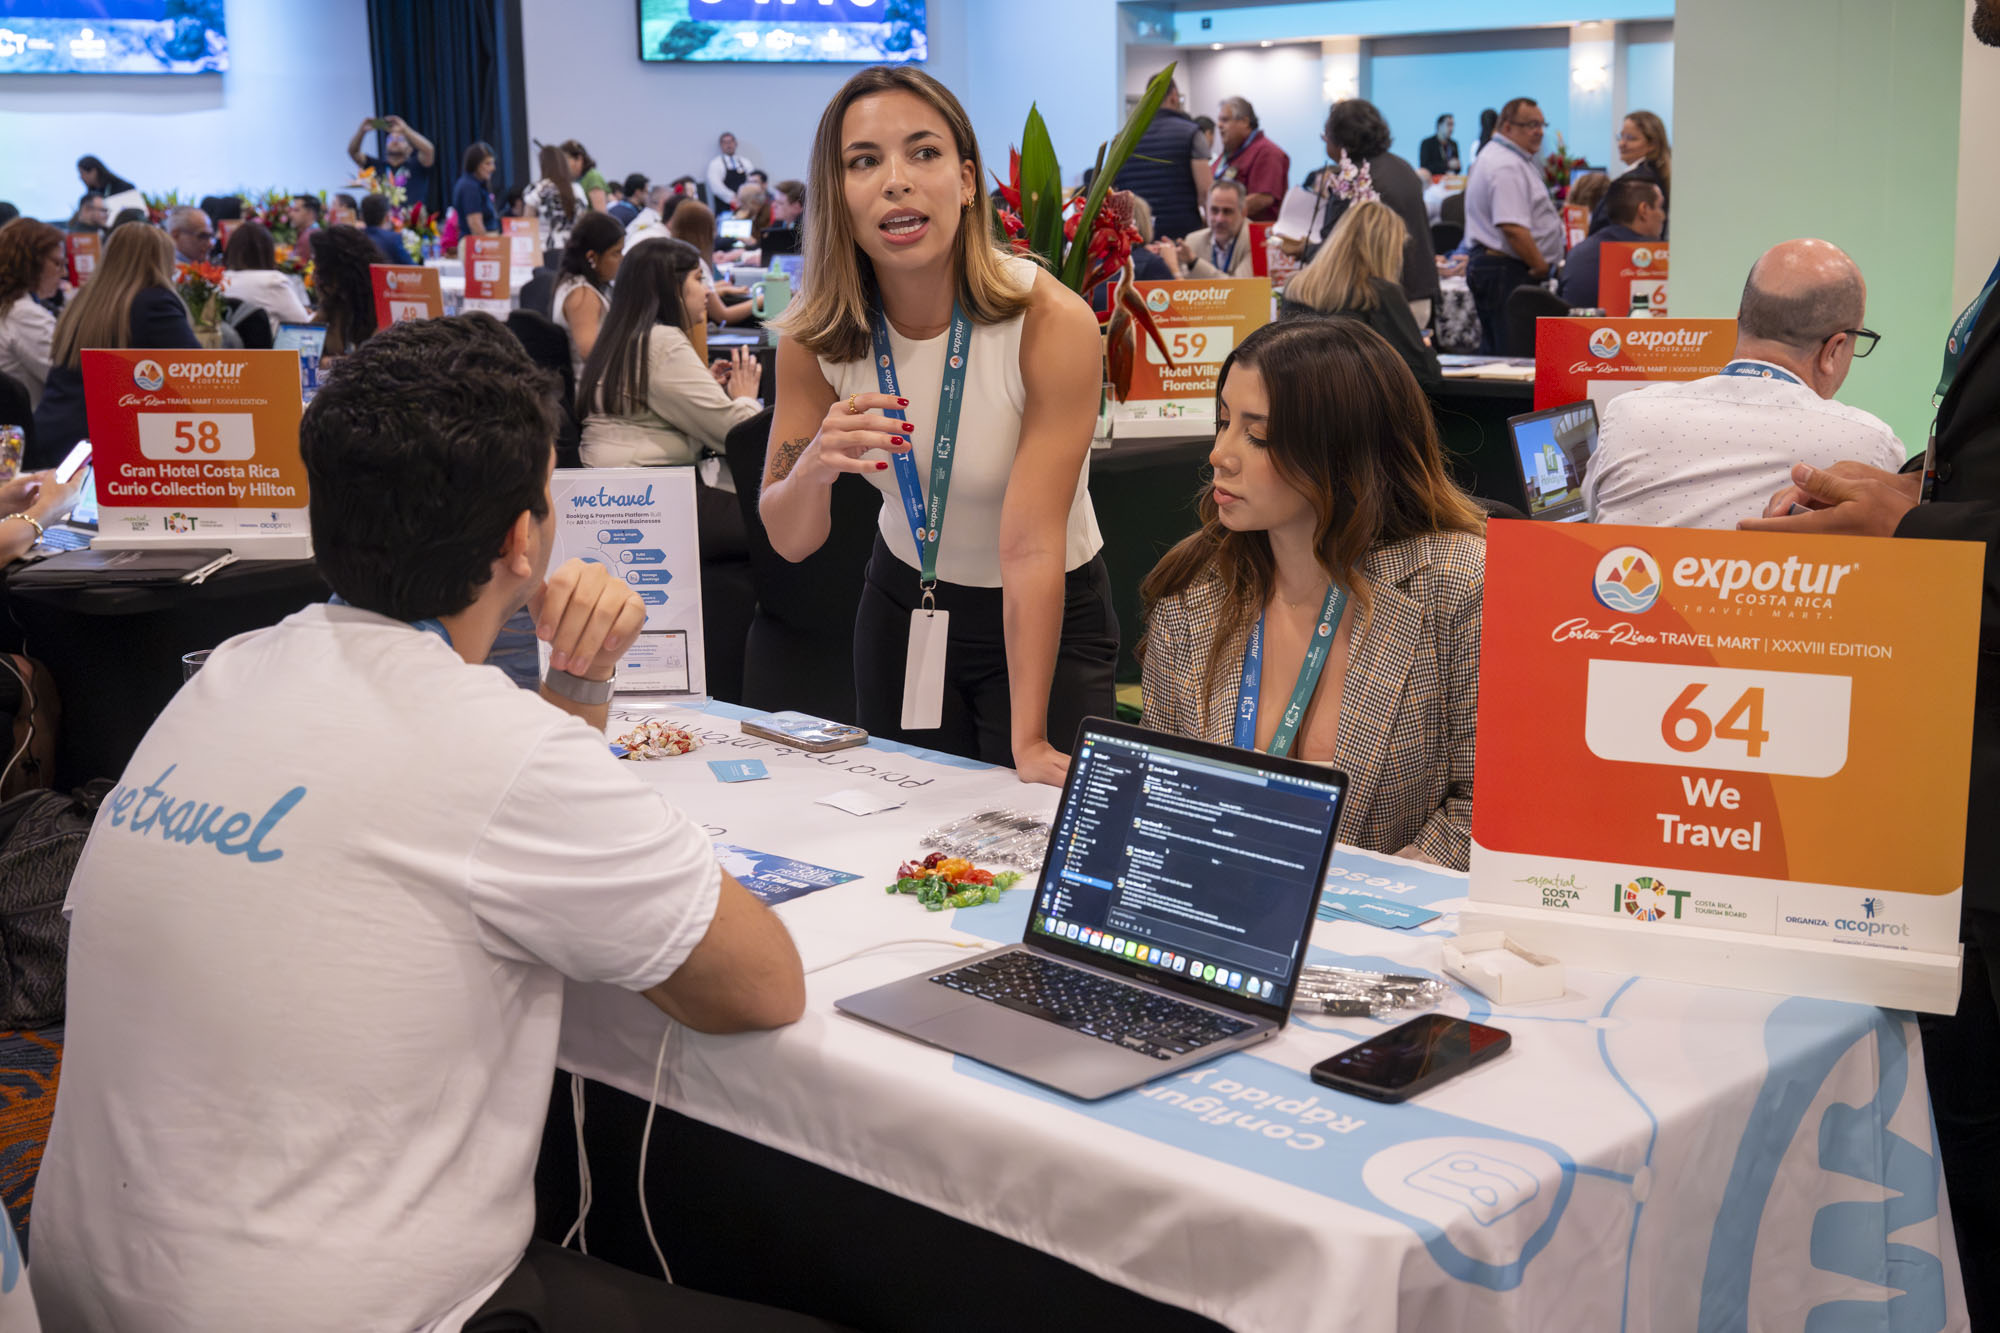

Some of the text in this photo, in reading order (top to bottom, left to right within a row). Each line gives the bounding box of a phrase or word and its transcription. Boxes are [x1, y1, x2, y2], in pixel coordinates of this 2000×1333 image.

[1172, 287, 1232, 304] expotur
[952, 319, 964, 354] expotur
[1173, 333, 1208, 358] 59
[1626, 328, 1709, 350] expotur
[168, 360, 245, 382] expotur
[1159, 365, 1220, 378] Hotel Villa
[1163, 379, 1217, 392] Florencia
[175, 421, 221, 454] 58
[937, 435, 951, 459] ICT
[120, 463, 280, 479] Gran Hotel Costa Rica
[107, 482, 295, 499] Curio Collection by Hilton
[571, 484, 655, 508] wetravel
[164, 512, 198, 533] ICT
[930, 494, 939, 527] expotur
[1672, 555, 1851, 600] expotur
[1324, 586, 1340, 621] expotur
[1684, 605, 1822, 620] TRAVEL MART
[1735, 592, 1833, 609] COSTA RICA
[1251, 623, 1260, 660] expotur
[1552, 618, 1893, 659] Costa Rica TRAVEL MART XXXVIII EDITION
[1242, 696, 1253, 720] ICT
[1285, 702, 1301, 728] ICT
[1661, 683, 1769, 758] 64
[848, 763, 935, 789] para
[1681, 776, 1741, 810] We
[1656, 813, 1761, 852] Travel
[1542, 888, 1580, 900] COSTA
[1542, 898, 1569, 908] RICA
[1614, 876, 1691, 922] ICT
[1695, 900, 1733, 910] COSTA RICA
[1695, 907, 1748, 919] TOURISM BOARD
[1785, 916, 1830, 927] ORGANIZA:
[1834, 918, 1910, 937] acoprot
[1209, 1079, 1367, 1134] Rápida
